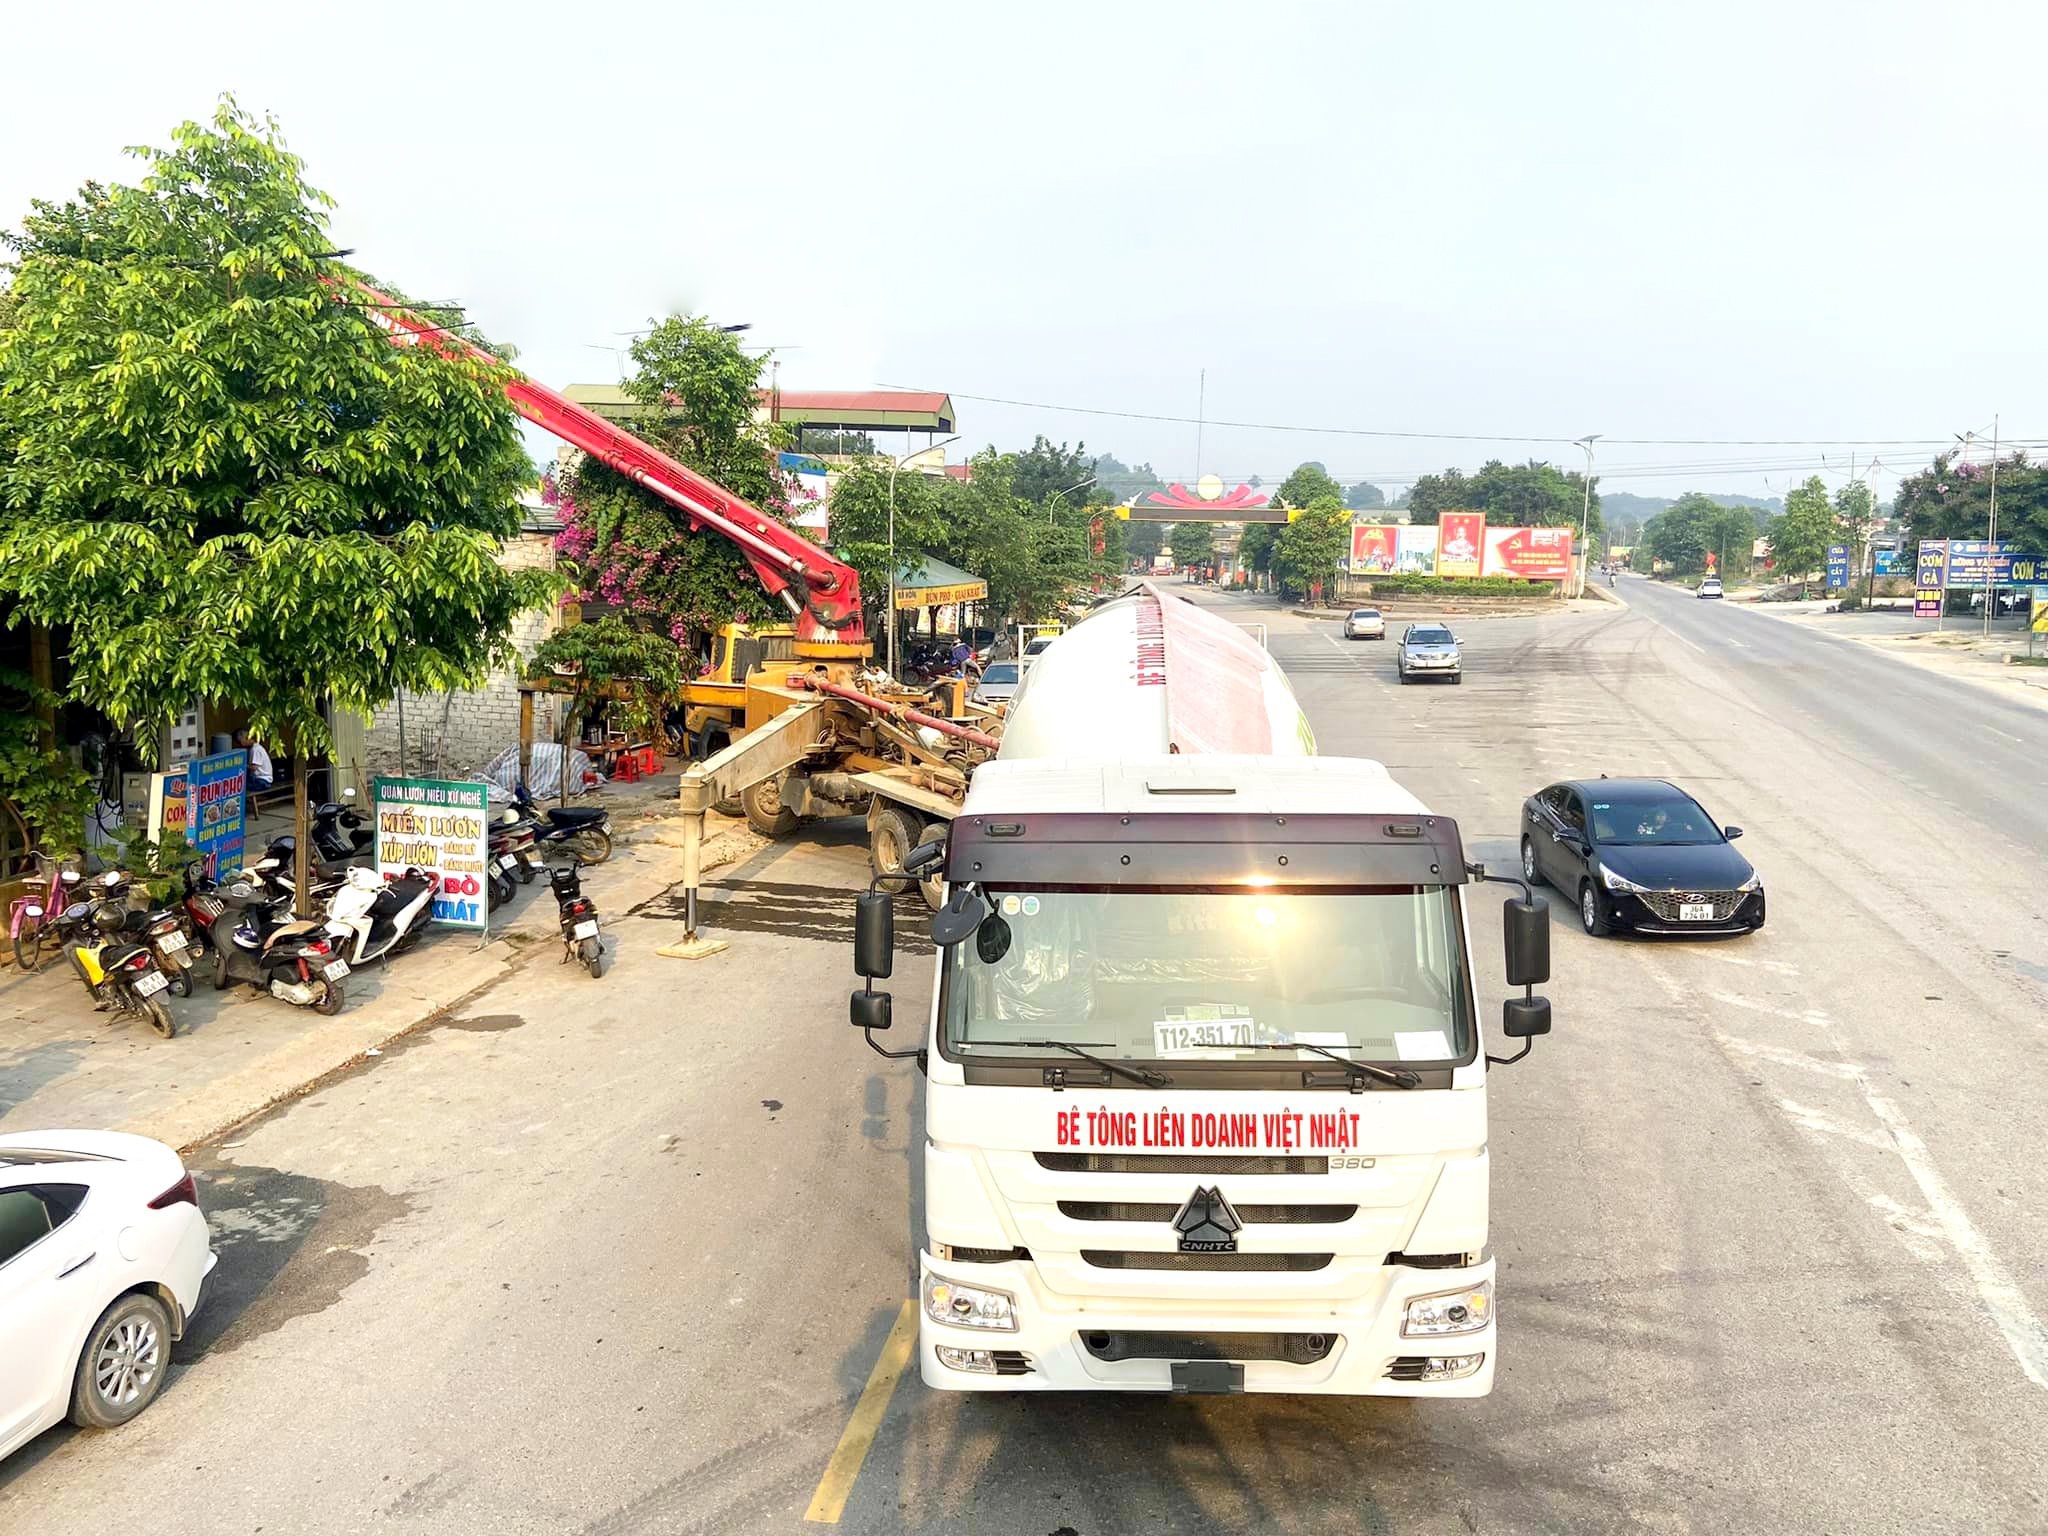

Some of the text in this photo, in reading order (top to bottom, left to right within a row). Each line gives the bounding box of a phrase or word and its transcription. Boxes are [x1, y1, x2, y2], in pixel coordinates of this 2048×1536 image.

[1920, 552, 1944, 568] CƠM
[2012, 560, 2034, 580] CƠM
[1922, 569, 1938, 584] GÀ
[200, 776, 222, 805] BÚN
[222, 768, 245, 798] PHỞ
[381, 807, 481, 838] MIẾN LƯƠN
[380, 836, 438, 867] XÚP LƯƠN
[444, 874, 481, 896] BÒ
[431, 899, 479, 922] KHÁT
[1057, 1105, 1360, 1154] BÊ TÔNG LIÊN DOANH VIỆT NHẬT
[1329, 1157, 1377, 1170] 380
[1180, 1241, 1235, 1251] CNHTC
